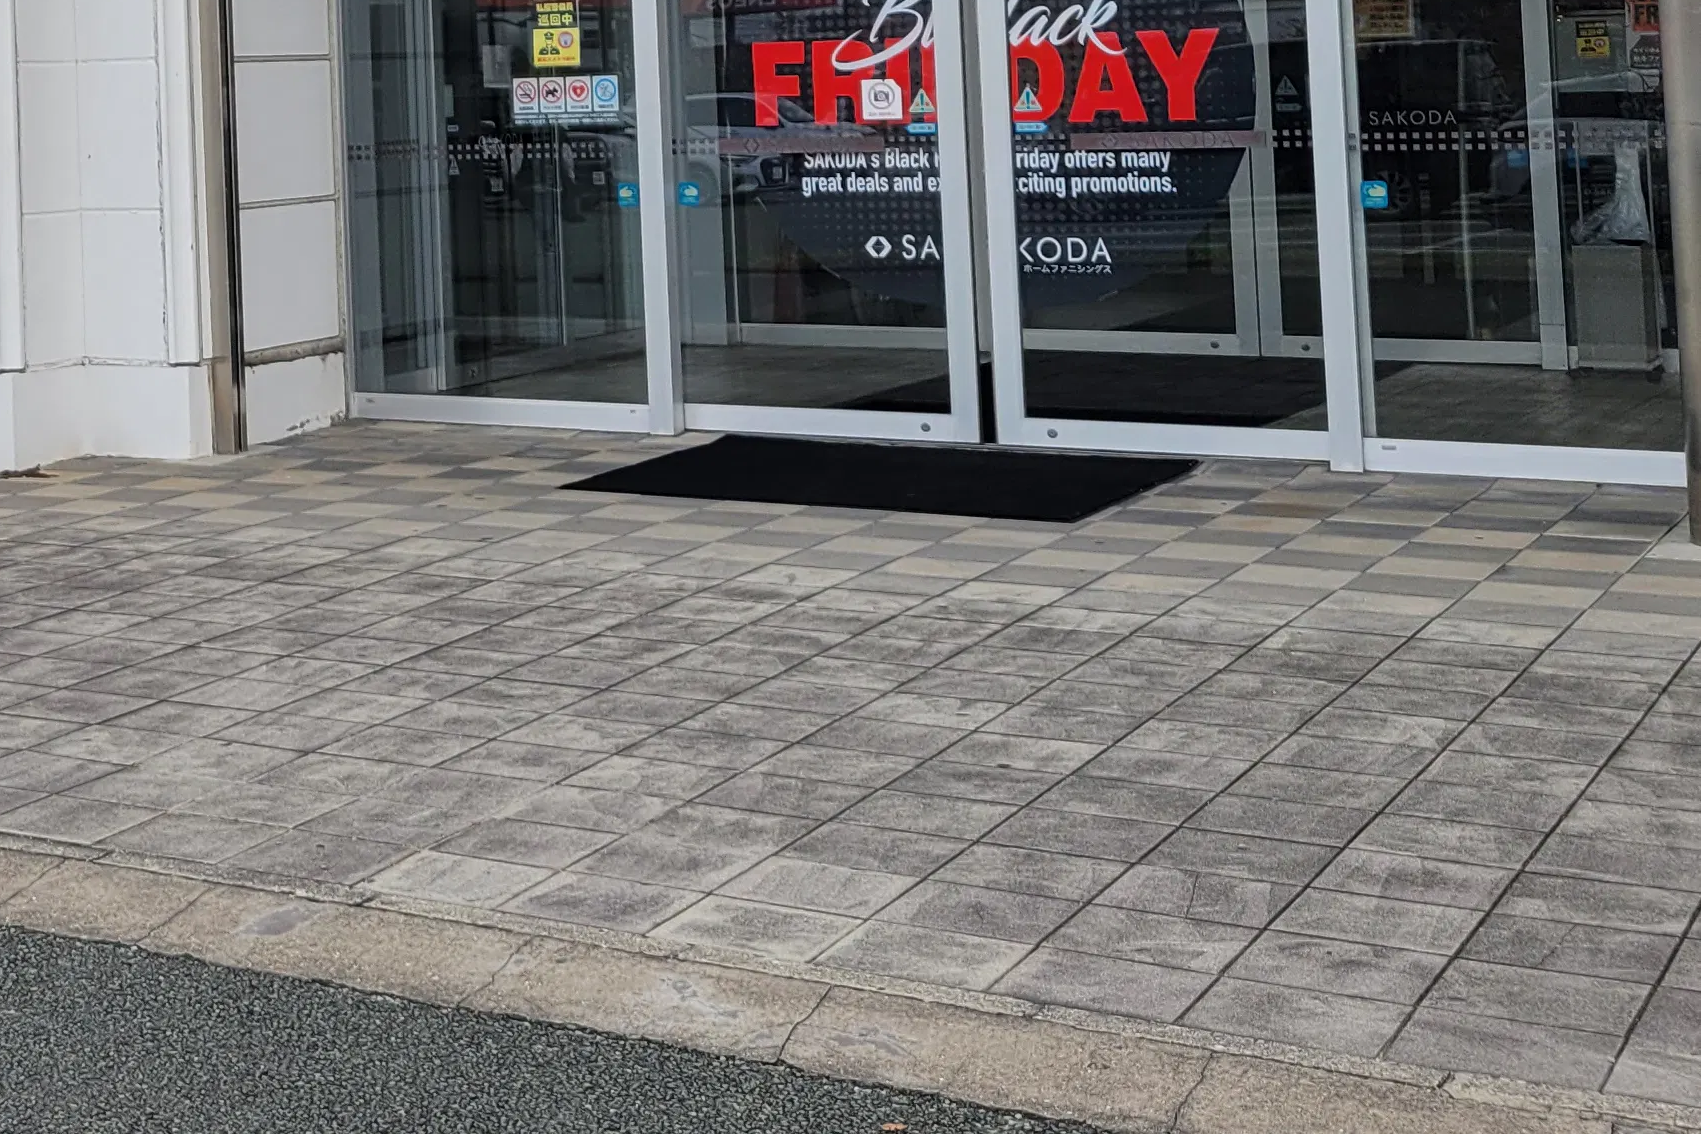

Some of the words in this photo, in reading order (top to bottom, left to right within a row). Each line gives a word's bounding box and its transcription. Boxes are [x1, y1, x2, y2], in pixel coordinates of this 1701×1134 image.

[1369, 110, 1457, 126] SAKODA
[884, 148, 931, 169] Black
[1064, 150, 1117, 169] offers
[1121, 151, 1172, 173] many
[801, 173, 844, 198] great
[847, 172, 889, 193] deals
[893, 172, 923, 193] and
[1071, 171, 1178, 198] promotions.
[1023, 264, 1113, 275] ホームファニシングス
